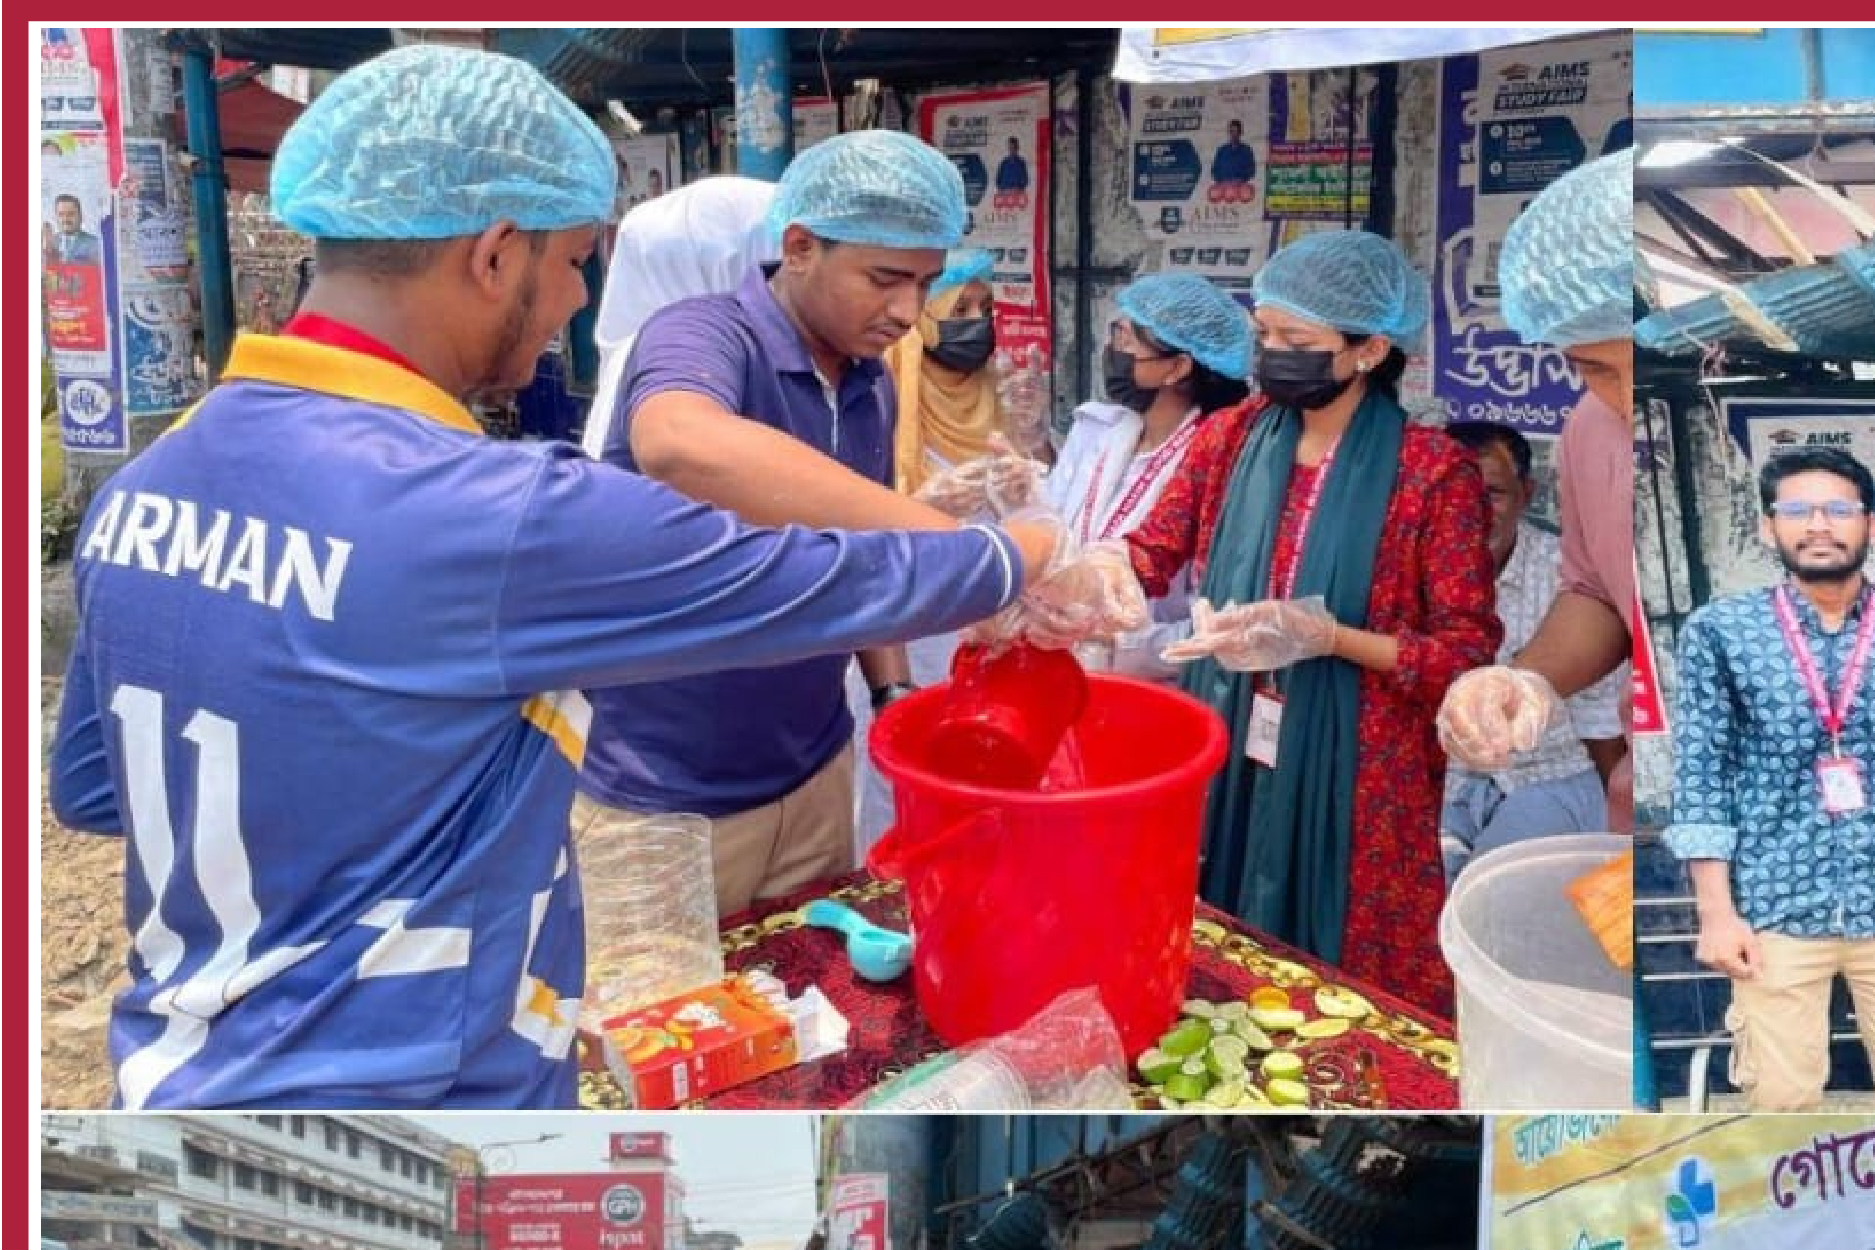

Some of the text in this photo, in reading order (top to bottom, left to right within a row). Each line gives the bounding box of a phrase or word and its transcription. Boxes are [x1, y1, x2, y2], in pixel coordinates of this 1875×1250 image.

[1539, 62, 1590, 79] AIMS
[1806, 432, 1853, 445] AIMS
[81, 489, 353, 621] ARMAN
